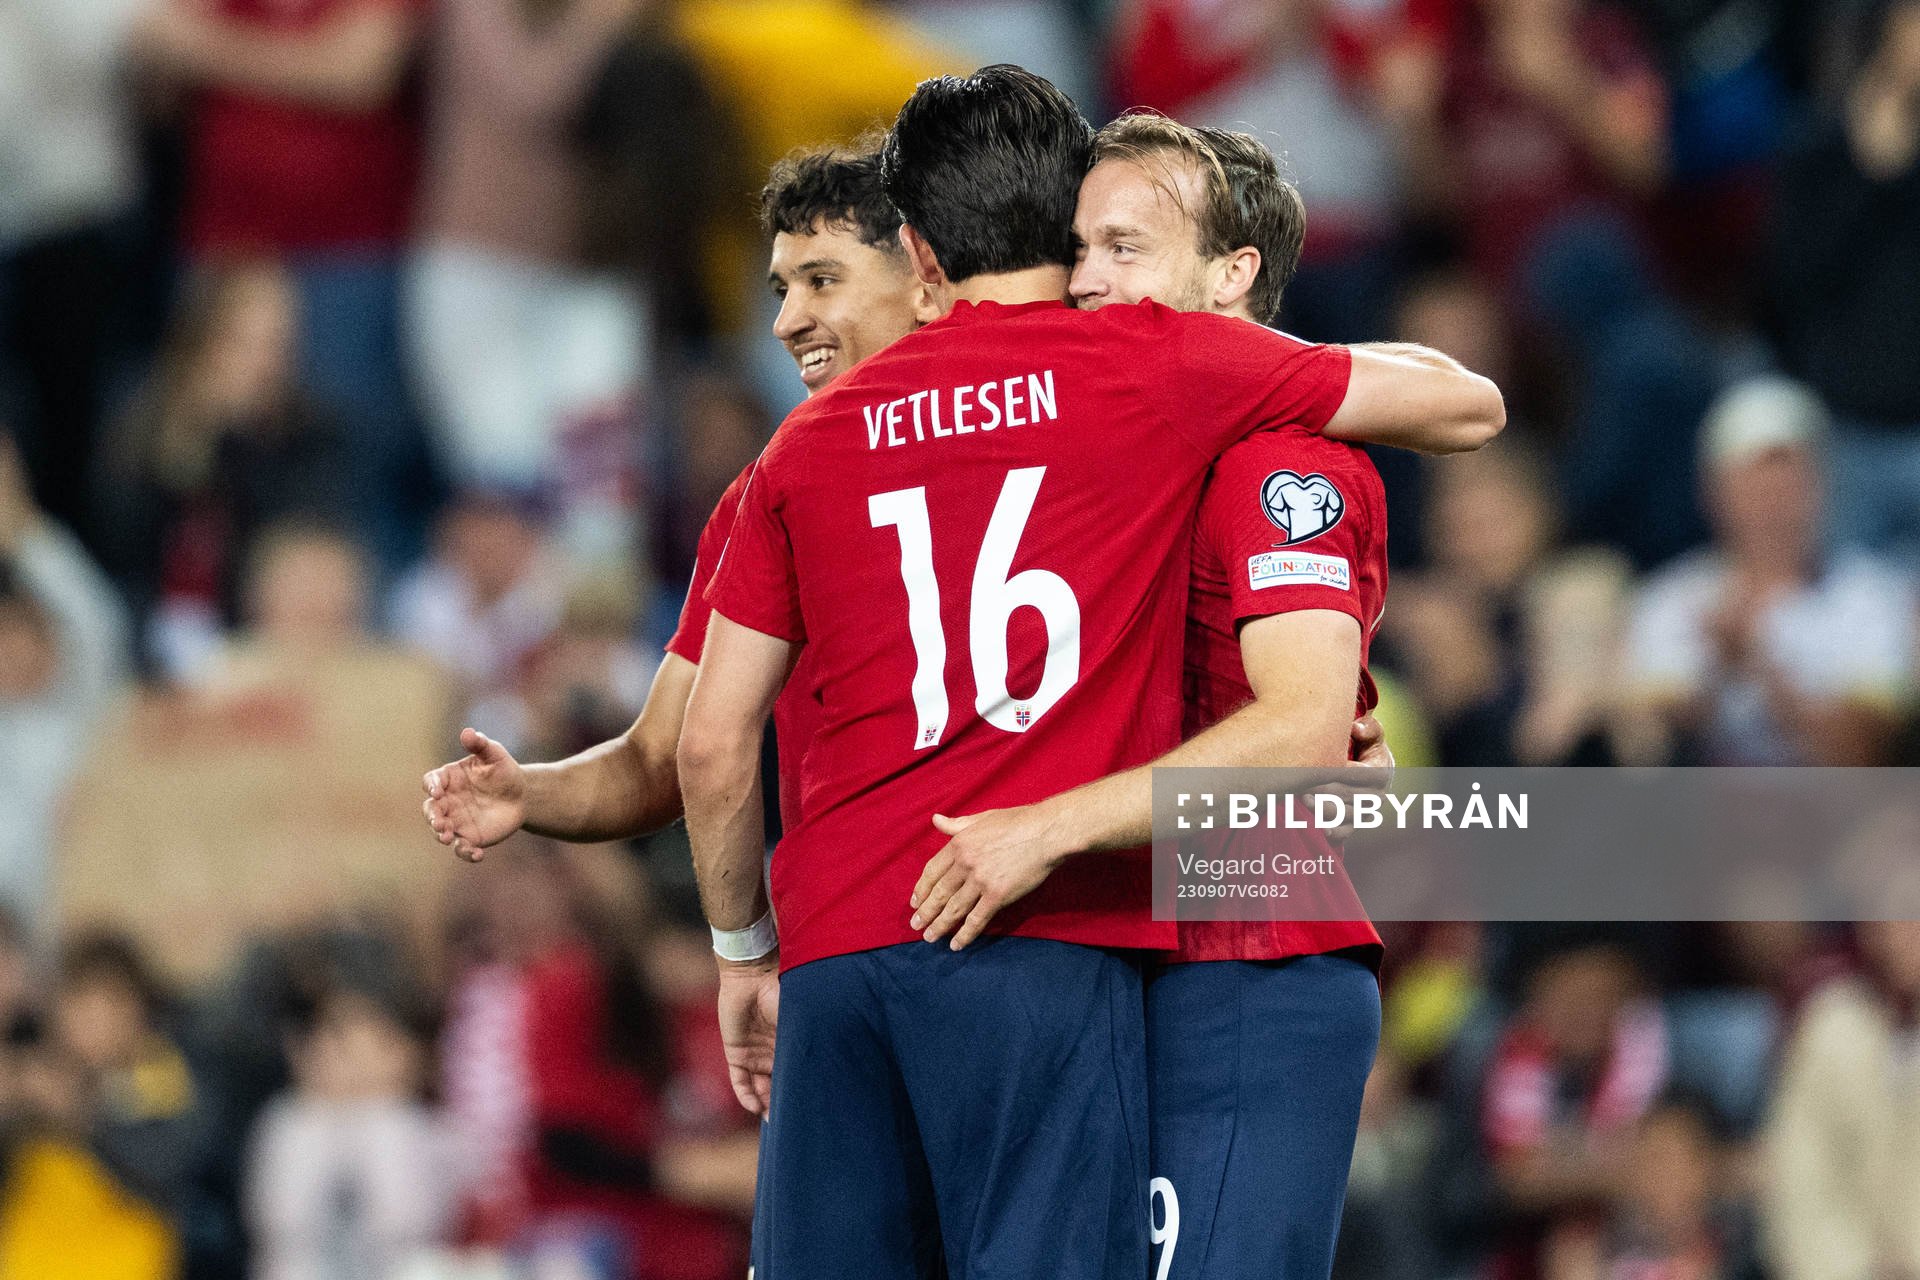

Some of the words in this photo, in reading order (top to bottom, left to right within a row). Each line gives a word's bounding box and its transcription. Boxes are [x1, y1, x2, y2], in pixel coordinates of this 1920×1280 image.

[863, 369, 1058, 450] VETLESEN
[1251, 554, 1272, 566] UEFA
[1251, 561, 1347, 578] FOUNDATION
[867, 465, 1081, 751] 16
[1150, 1177, 1180, 1280] 9
